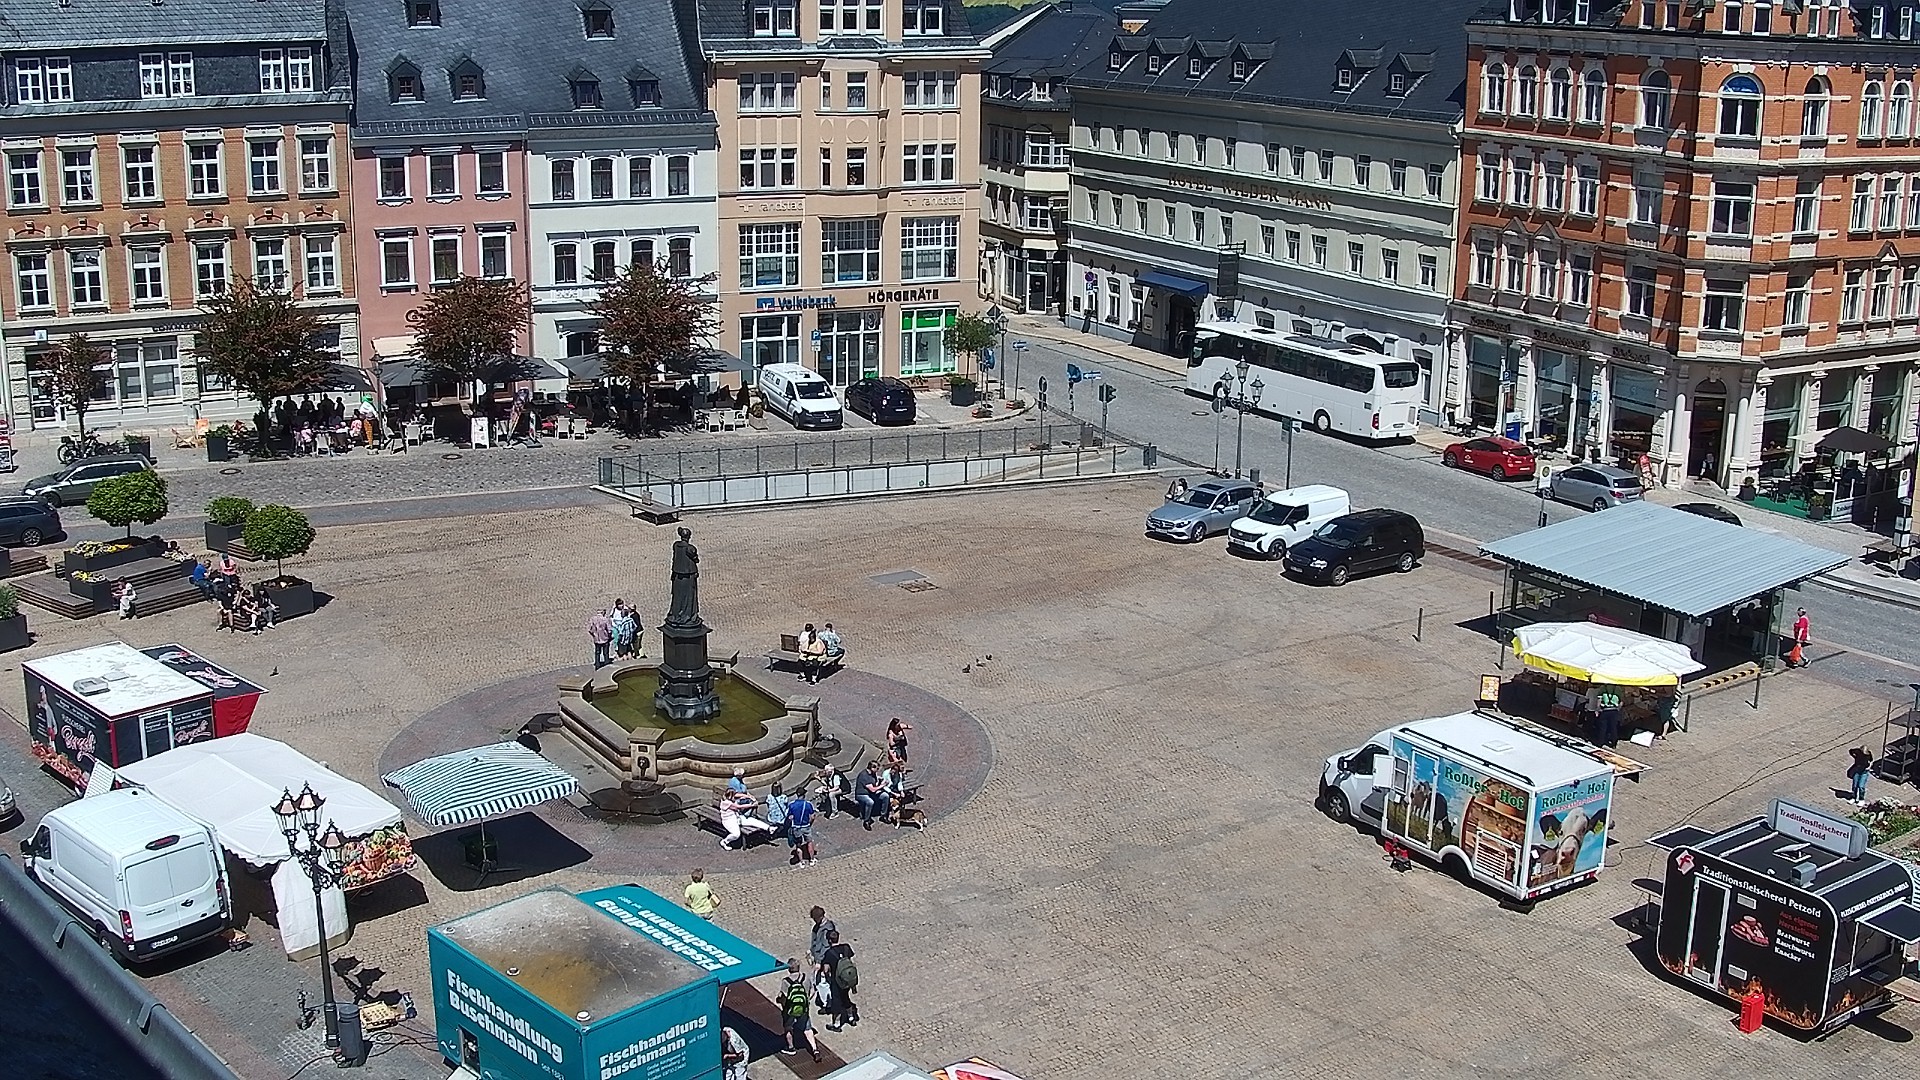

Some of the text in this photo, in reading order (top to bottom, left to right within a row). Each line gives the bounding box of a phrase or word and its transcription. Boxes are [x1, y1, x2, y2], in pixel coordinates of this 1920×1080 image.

[1168, 172, 1333, 211] HOTEL WILDER MANN
[778, 294, 837, 311] Volksbank
[868, 287, 939, 304] HÖRGERÄTE
[1499, 789, 1524, 810] Hof
[1587, 780, 1607, 795] Hof
[1780, 809, 1850, 839] Traditionsfleischerei
[1800, 825, 1826, 841] Petzold
[1702, 865, 1822, 918] Traditionsfleischerei Petzold
[594, 899, 724, 972] Fischhandlung
[638, 909, 742, 967] Buschmann
[446, 968, 563, 1064] Fischhandlung
[448, 989, 538, 1065] Buschmann
[599, 1014, 708, 1069] Fischhandlung
[601, 1037, 686, 1080] Buschmann
